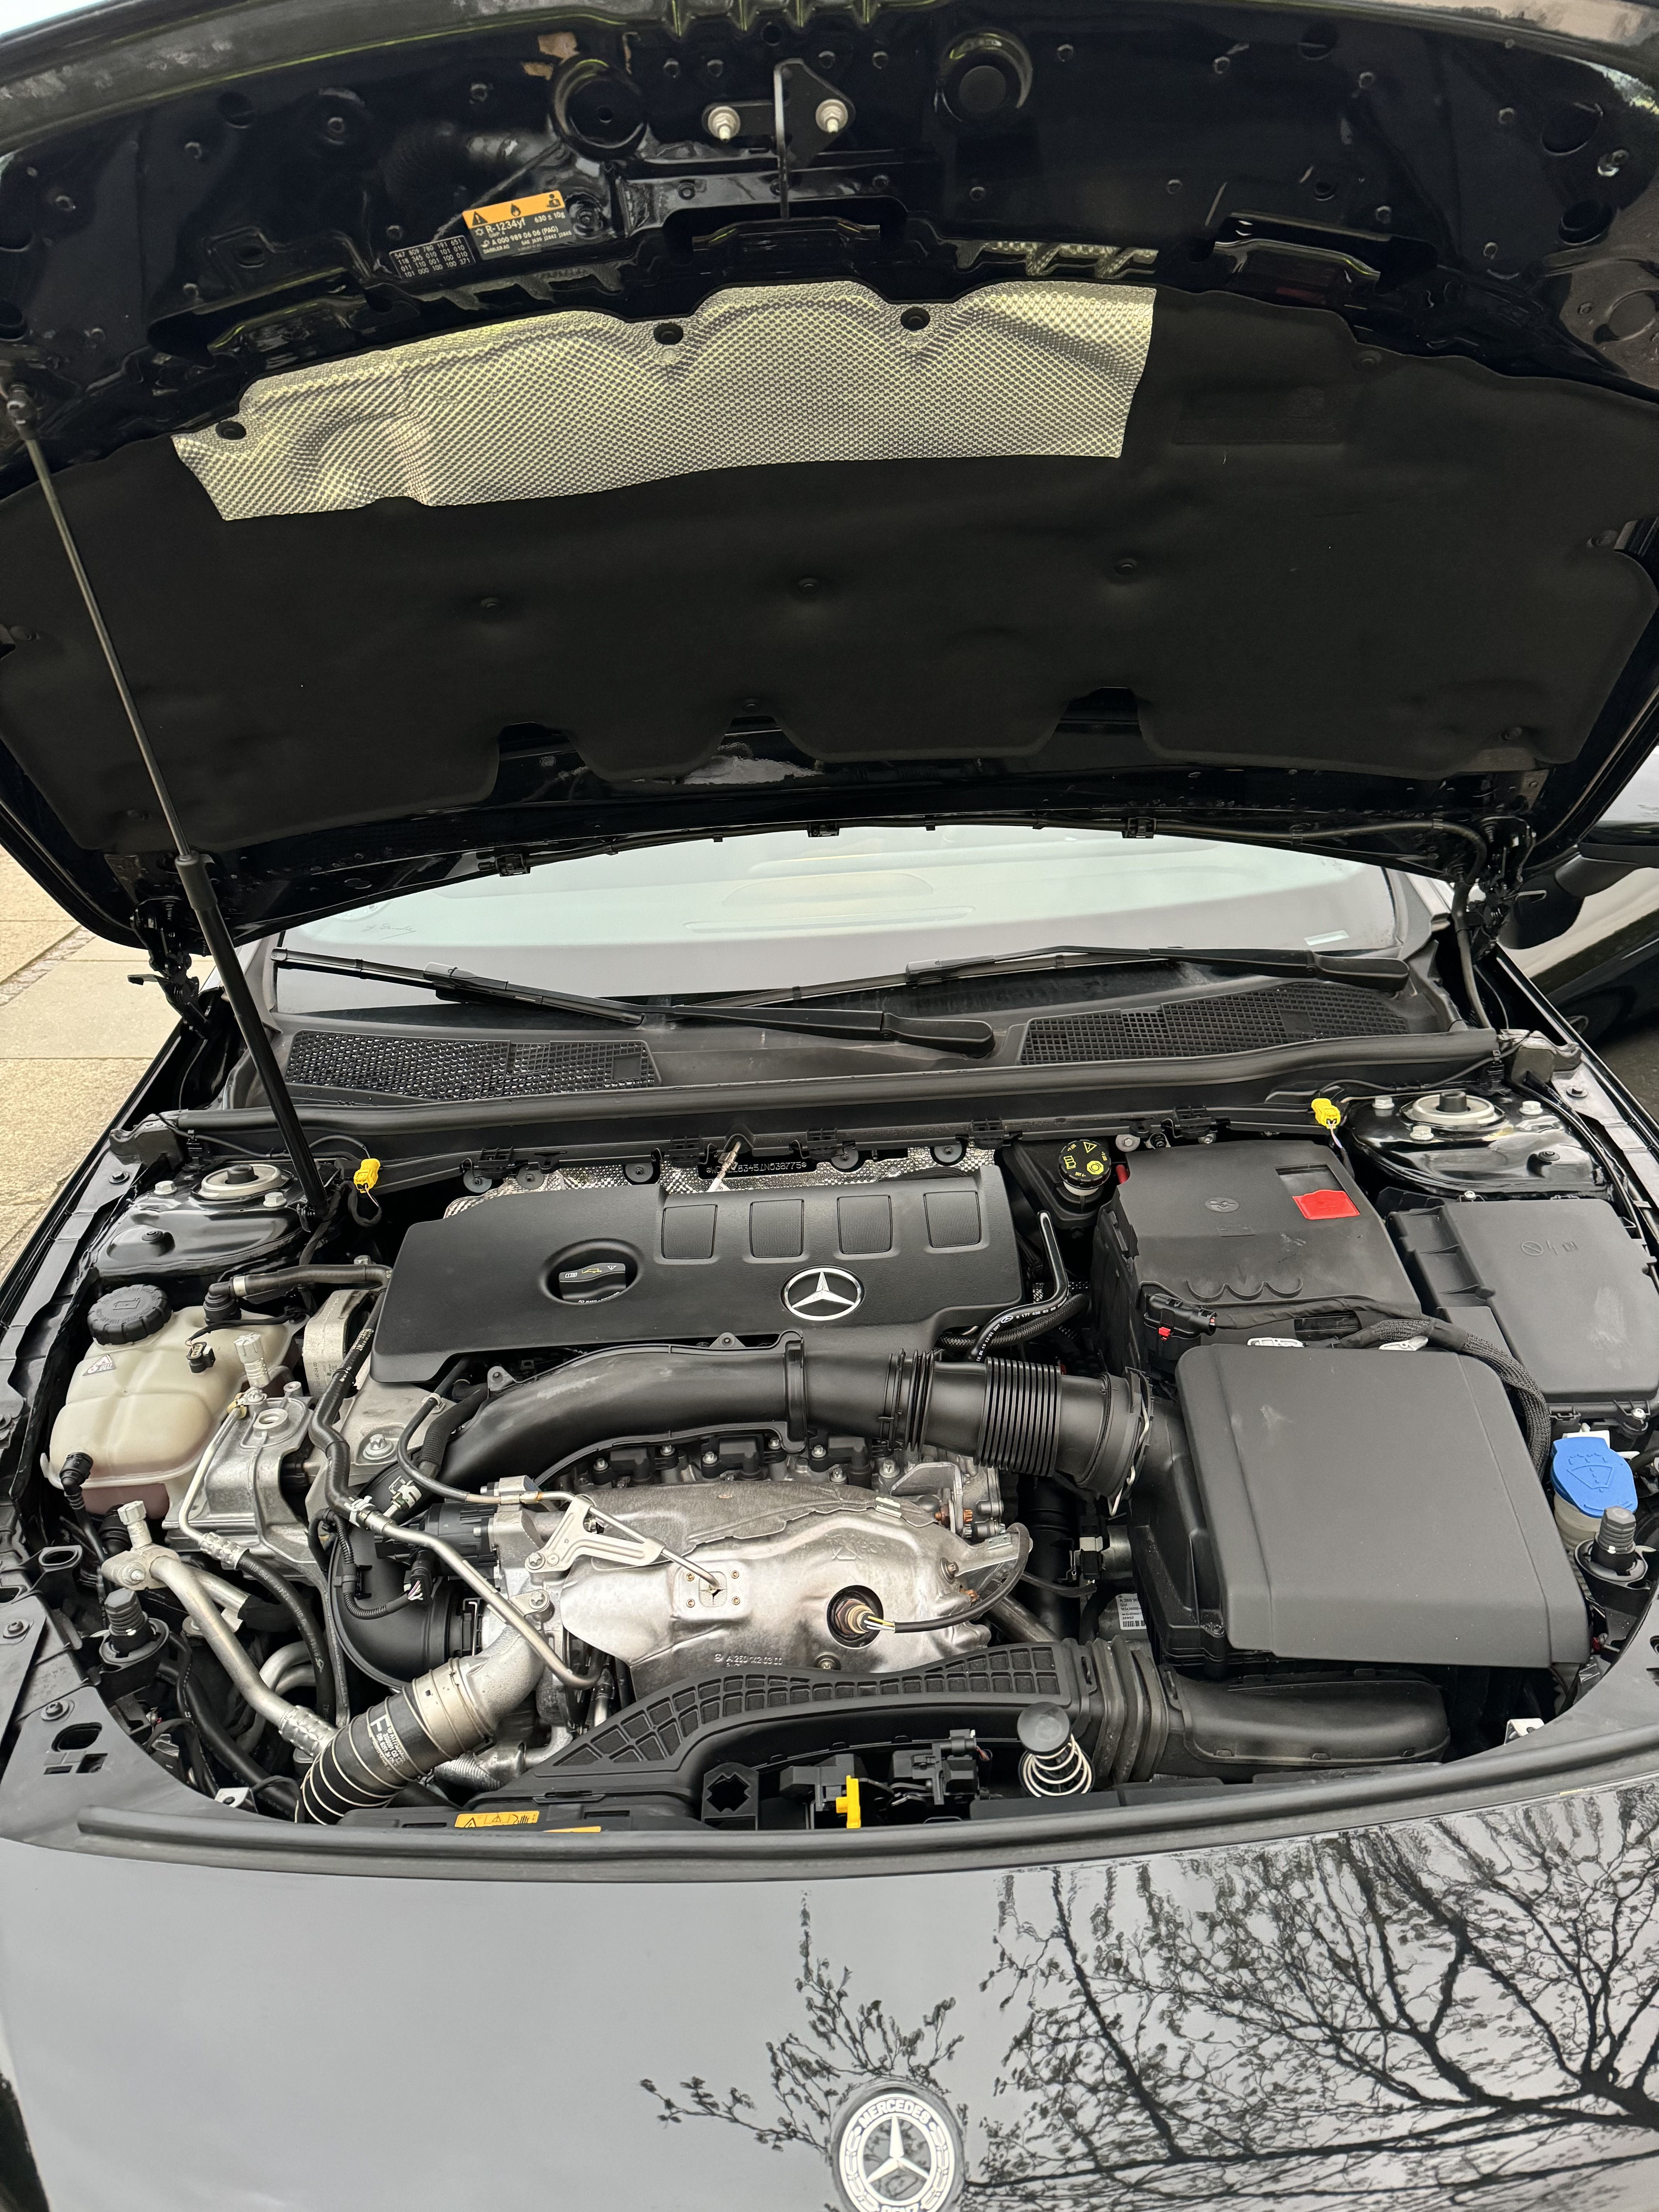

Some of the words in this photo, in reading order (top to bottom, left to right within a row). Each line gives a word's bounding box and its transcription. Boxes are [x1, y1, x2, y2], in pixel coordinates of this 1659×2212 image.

[485, 218, 526, 234] R-1234yf
[534, 215, 546, 223] 630
[542, 226, 558, 235] (PAG)
[711, 1162, 801, 1173] WD83451N036775
[858, 2099, 931, 2128] MERCEDES
